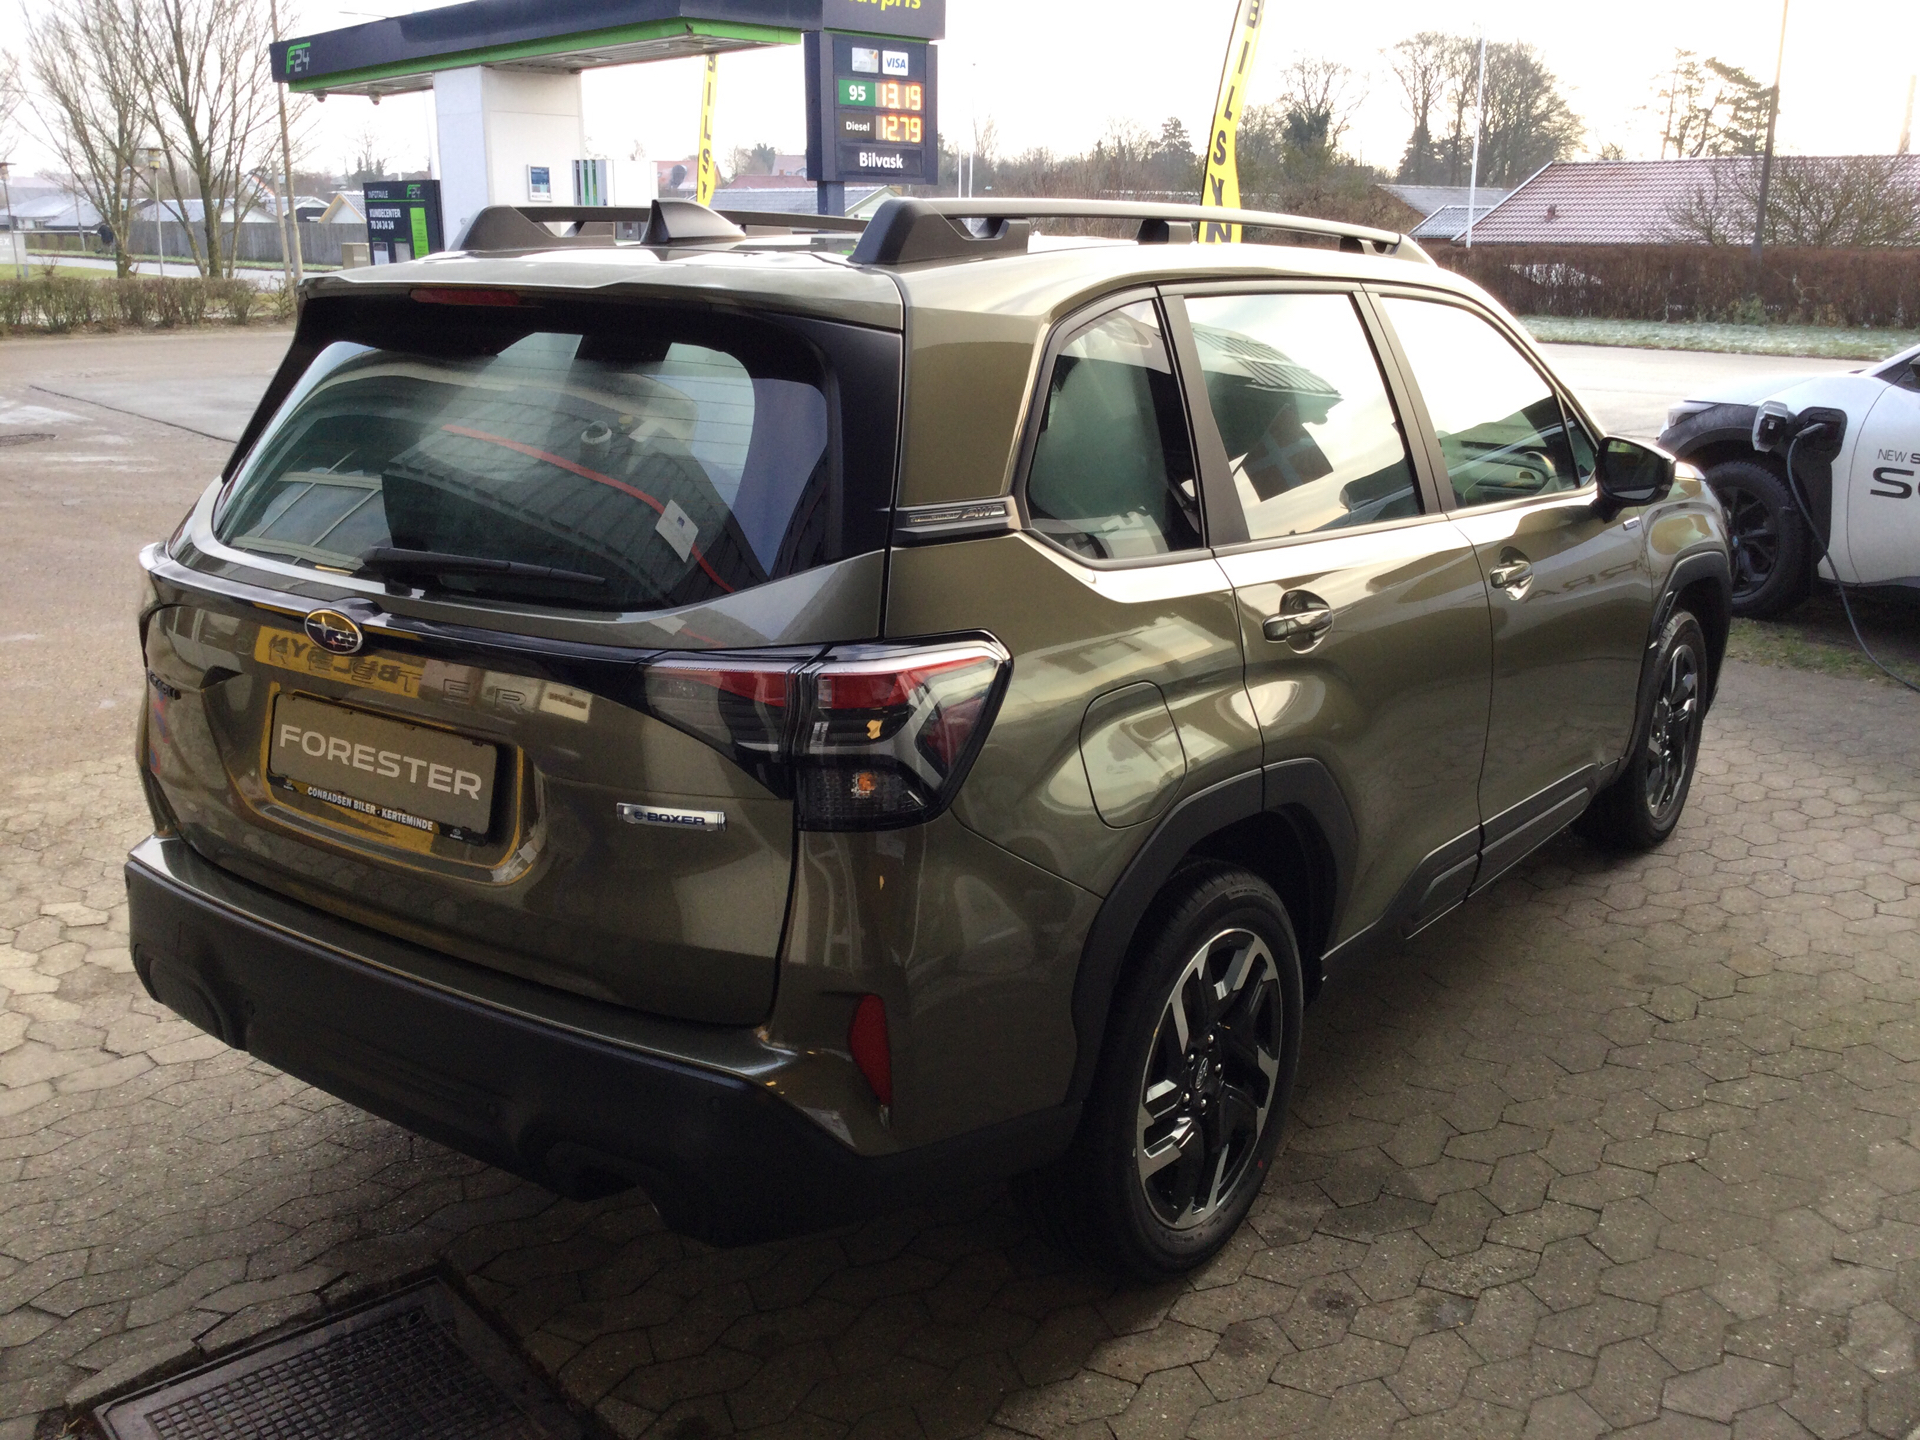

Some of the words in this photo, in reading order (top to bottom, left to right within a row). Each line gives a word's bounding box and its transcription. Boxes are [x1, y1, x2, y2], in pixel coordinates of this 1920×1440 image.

[285, 42, 311, 74] F24
[886, 57, 906, 69] VISA
[848, 85, 867, 102] 95
[702, 55, 716, 200] BILSY
[845, 121, 870, 132] Diesel
[881, 115, 922, 143] 12.79
[859, 152, 904, 169] Bilvask
[1877, 448, 1908, 463] NEW
[1870, 467, 1920, 499] S
[279, 724, 482, 800] FORESTER
[307, 786, 352, 807] CONRADSEN
[353, 800, 376, 815] BILER
[381, 808, 434, 831] KERTEMINDE
[634, 811, 705, 825] e-BOXER
